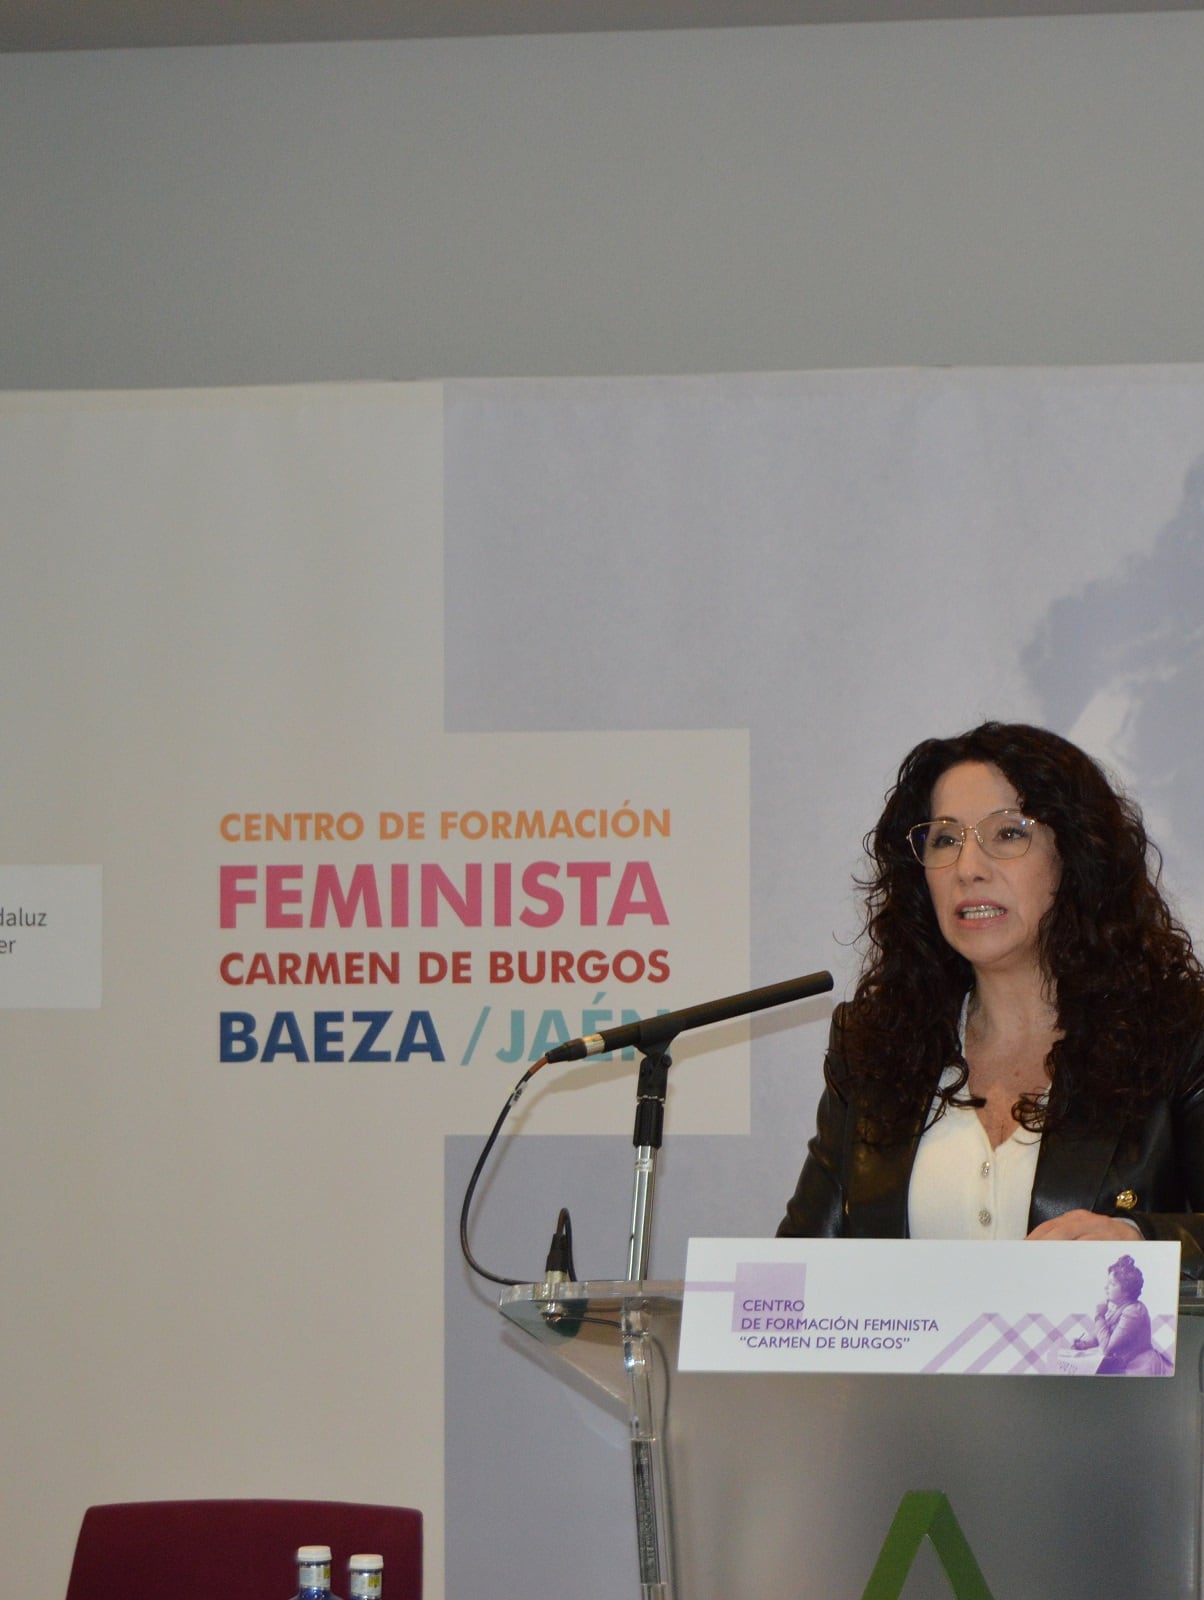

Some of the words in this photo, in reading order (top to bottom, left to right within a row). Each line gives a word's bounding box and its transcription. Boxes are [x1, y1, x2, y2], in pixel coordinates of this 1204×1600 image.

[219, 812, 364, 842] CENTRO
[379, 811, 425, 841] DE
[440, 800, 671, 840] FORMACIÓN
[219, 861, 670, 929] FEMINISTA
[219, 952, 400, 985] CARMEN
[419, 951, 472, 984] DE
[489, 949, 670, 984] BURGOS
[219, 1010, 446, 1063] BAEZA
[741, 1318, 761, 1330] DE
[766, 1316, 859, 1331] FORMACIÓN
[864, 1319, 939, 1331] FEMINISTA
[742, 1299, 805, 1312] CENTRO
[816, 1337, 836, 1349] DE
